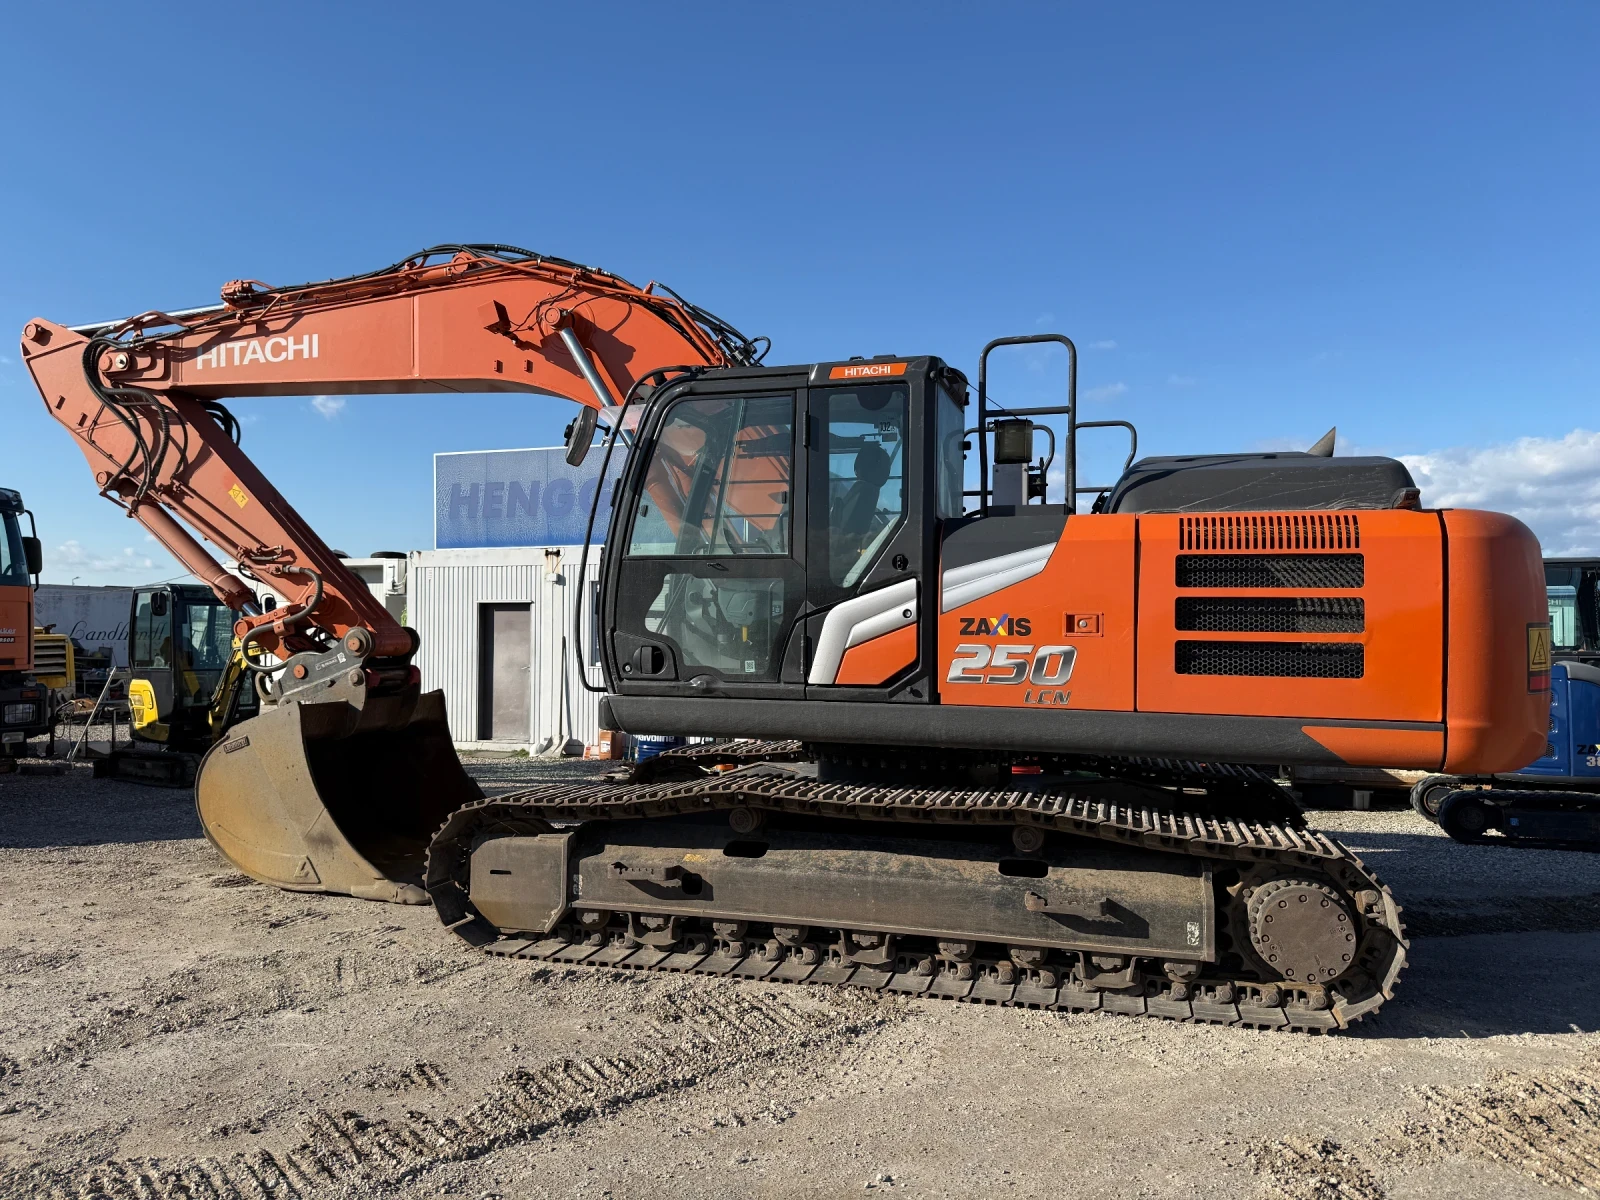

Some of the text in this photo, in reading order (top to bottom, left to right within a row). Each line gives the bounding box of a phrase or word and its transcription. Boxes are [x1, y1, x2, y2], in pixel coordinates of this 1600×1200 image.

[196, 333, 319, 370] HITACHI
[844, 365, 891, 377] HITACHI
[959, 613, 1032, 637] ZAXIS
[946, 643, 1078, 687] 250
[1023, 689, 1072, 705] LCN
